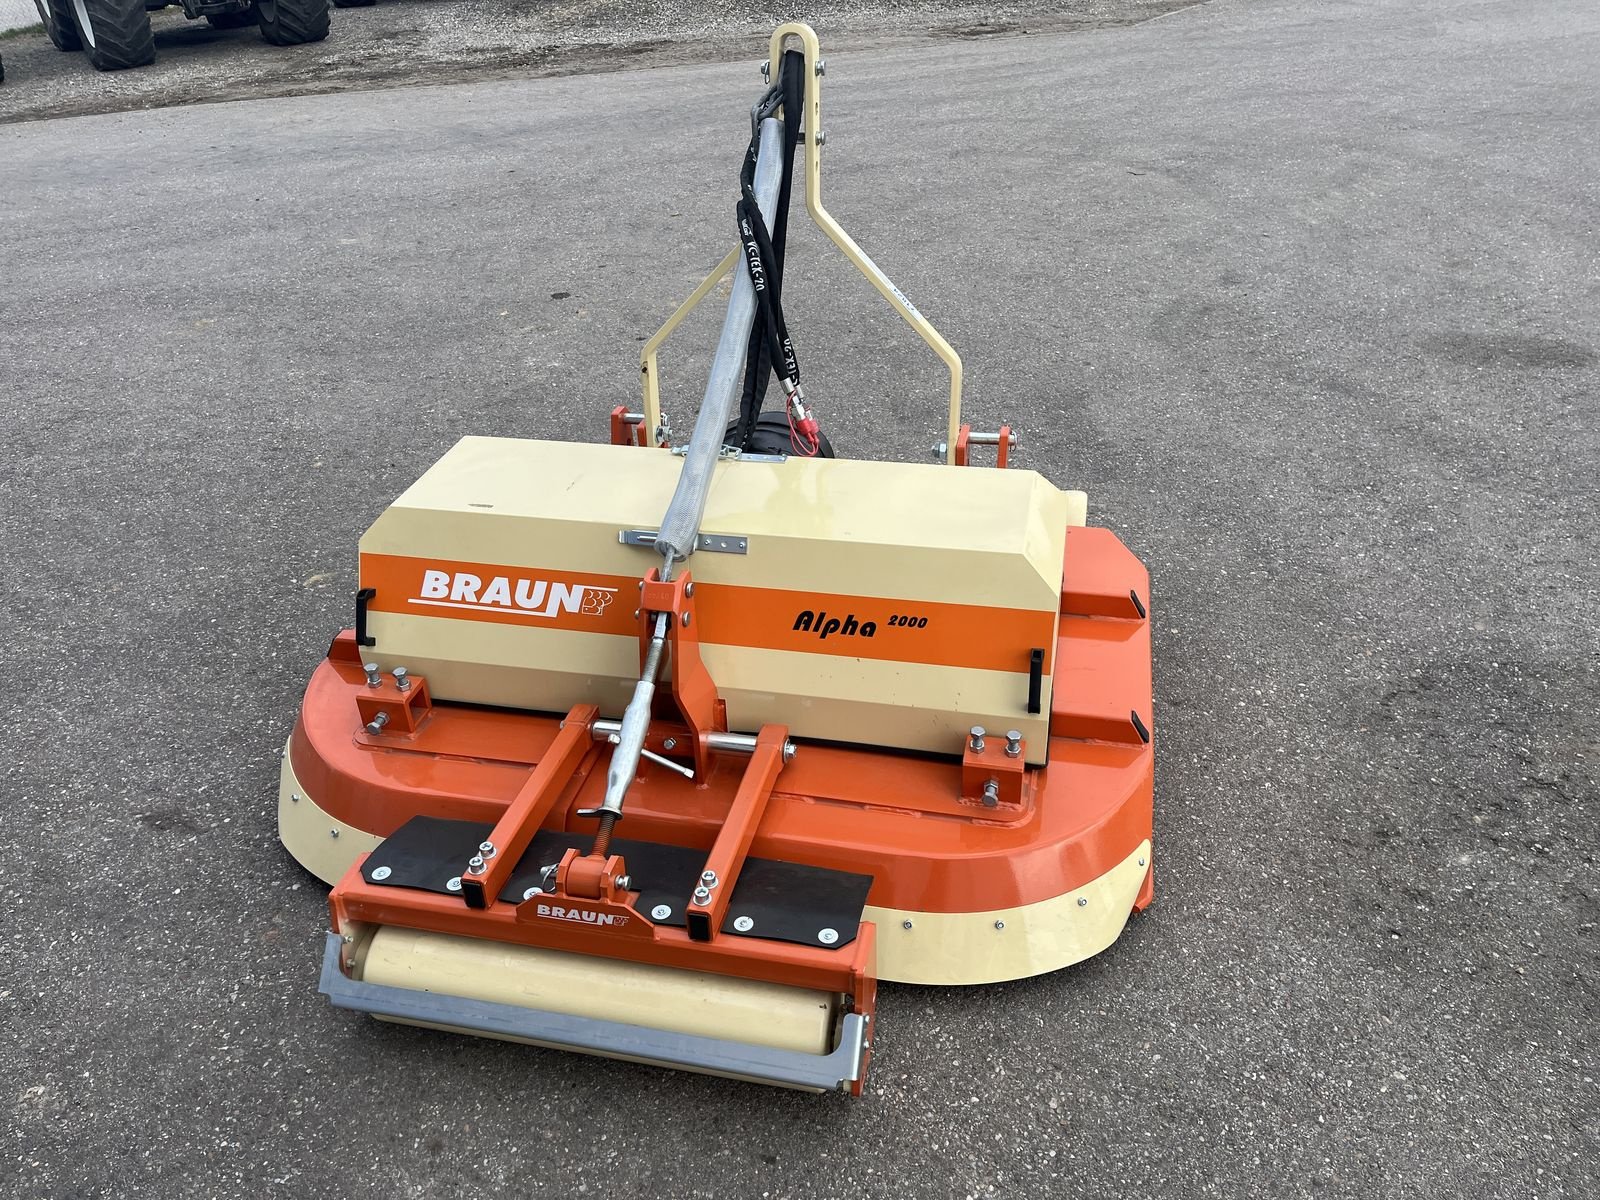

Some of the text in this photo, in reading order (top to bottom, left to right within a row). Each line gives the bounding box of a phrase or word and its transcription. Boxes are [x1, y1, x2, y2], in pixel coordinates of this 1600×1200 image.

[420, 569, 585, 618] BRAUN
[792, 610, 928, 639] Alpha 2000
[537, 904, 614, 926] BRAUN
